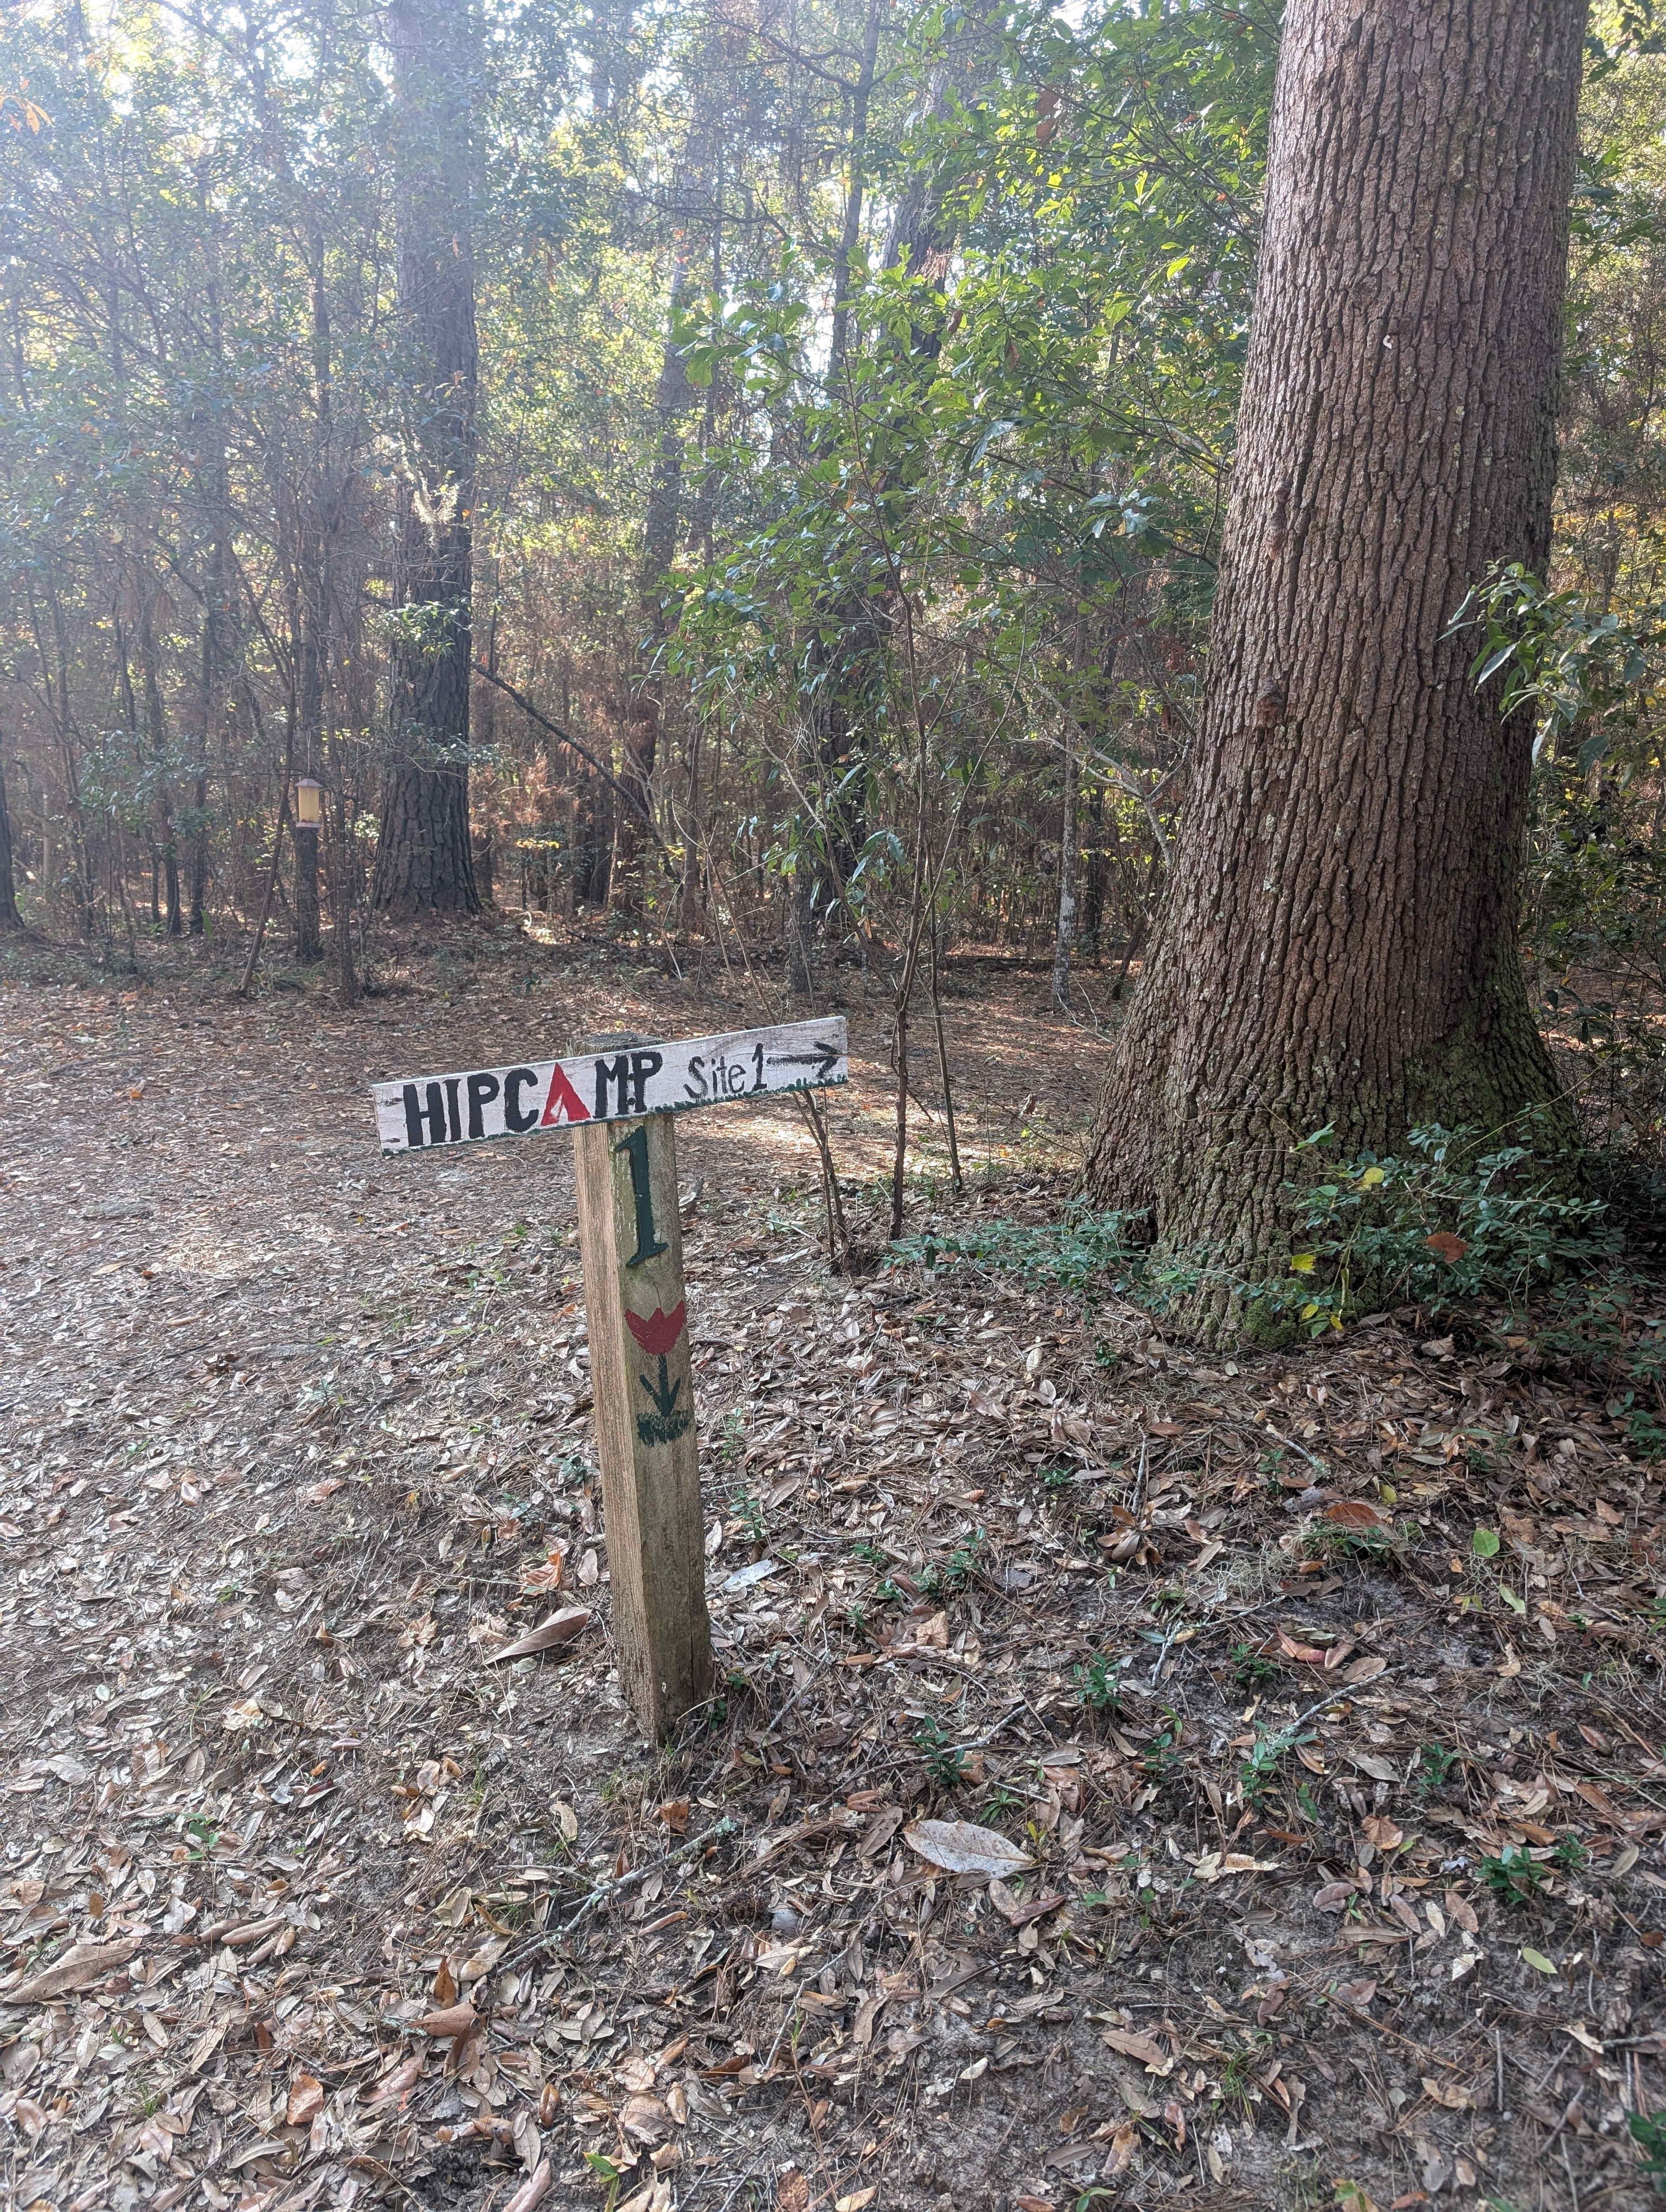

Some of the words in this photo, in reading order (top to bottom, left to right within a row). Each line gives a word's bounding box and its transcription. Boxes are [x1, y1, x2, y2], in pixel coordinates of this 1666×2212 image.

[403, 1052, 663, 1147] HIPCAMP
[683, 1056, 746, 1099] Site
[752, 1043, 767, 1091] 1
[615, 1126, 669, 1268] 1
